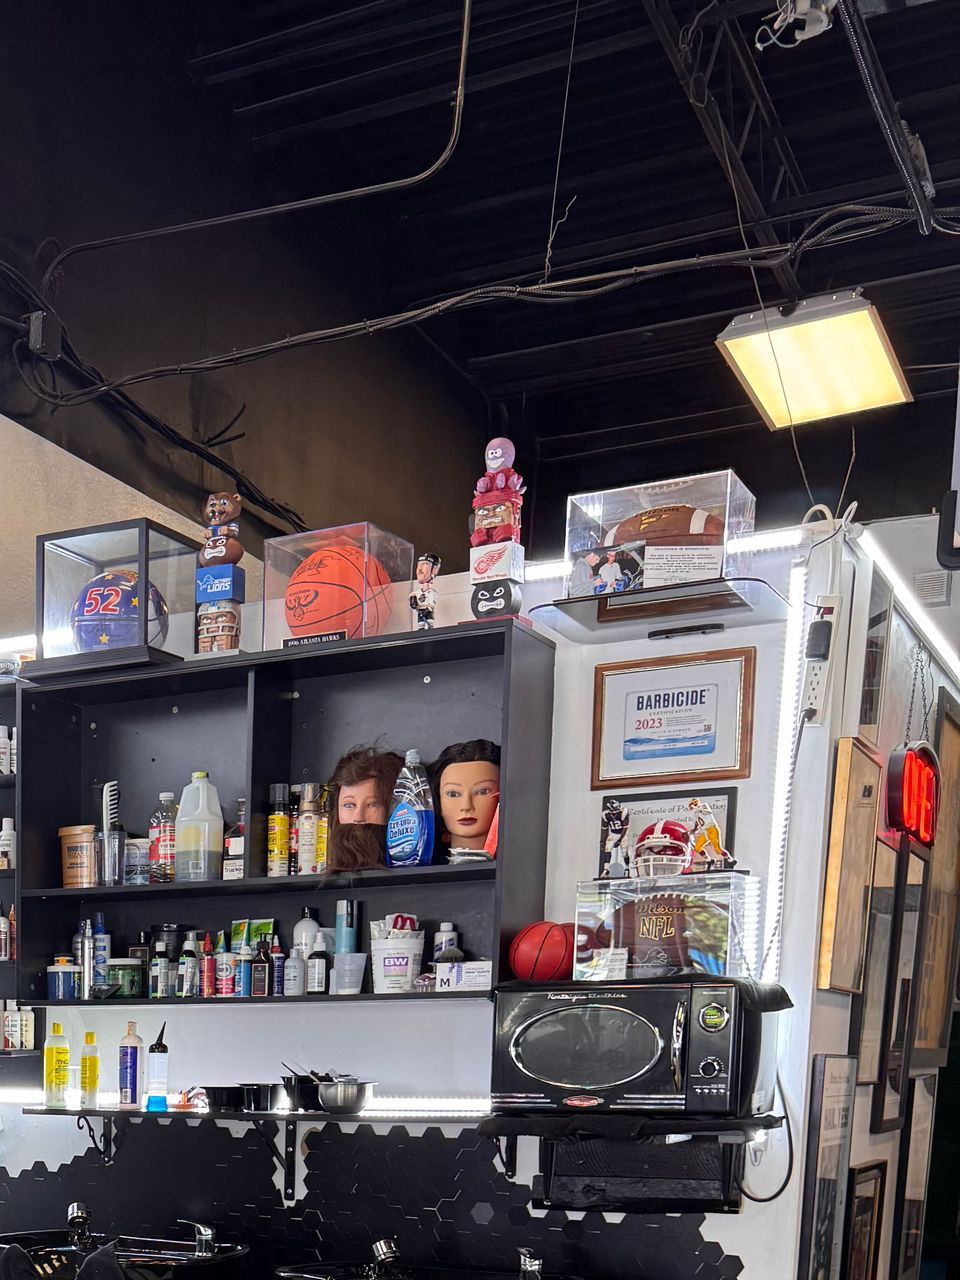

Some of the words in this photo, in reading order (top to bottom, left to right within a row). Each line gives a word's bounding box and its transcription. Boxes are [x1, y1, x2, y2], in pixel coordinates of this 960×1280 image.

[207, 582, 230, 592] LIONS
[84, 587, 121, 615] 52
[300, 637, 320, 645] ATLANTA
[321, 634, 340, 642] HAWKS
[637, 689, 706, 711] BARBICIDE
[649, 708, 692, 716] CERTIFICATION
[635, 717, 663, 731] 2023
[627, 806, 667, 817] Certificate
[668, 804, 675, 813] of
[609, 820, 622, 830] 12
[390, 827, 415, 839] Deluxe
[636, 903, 685, 914] Wilson
[639, 915, 675, 940] NFL
[384, 957, 407, 966] BW
[440, 977, 450, 988] M
